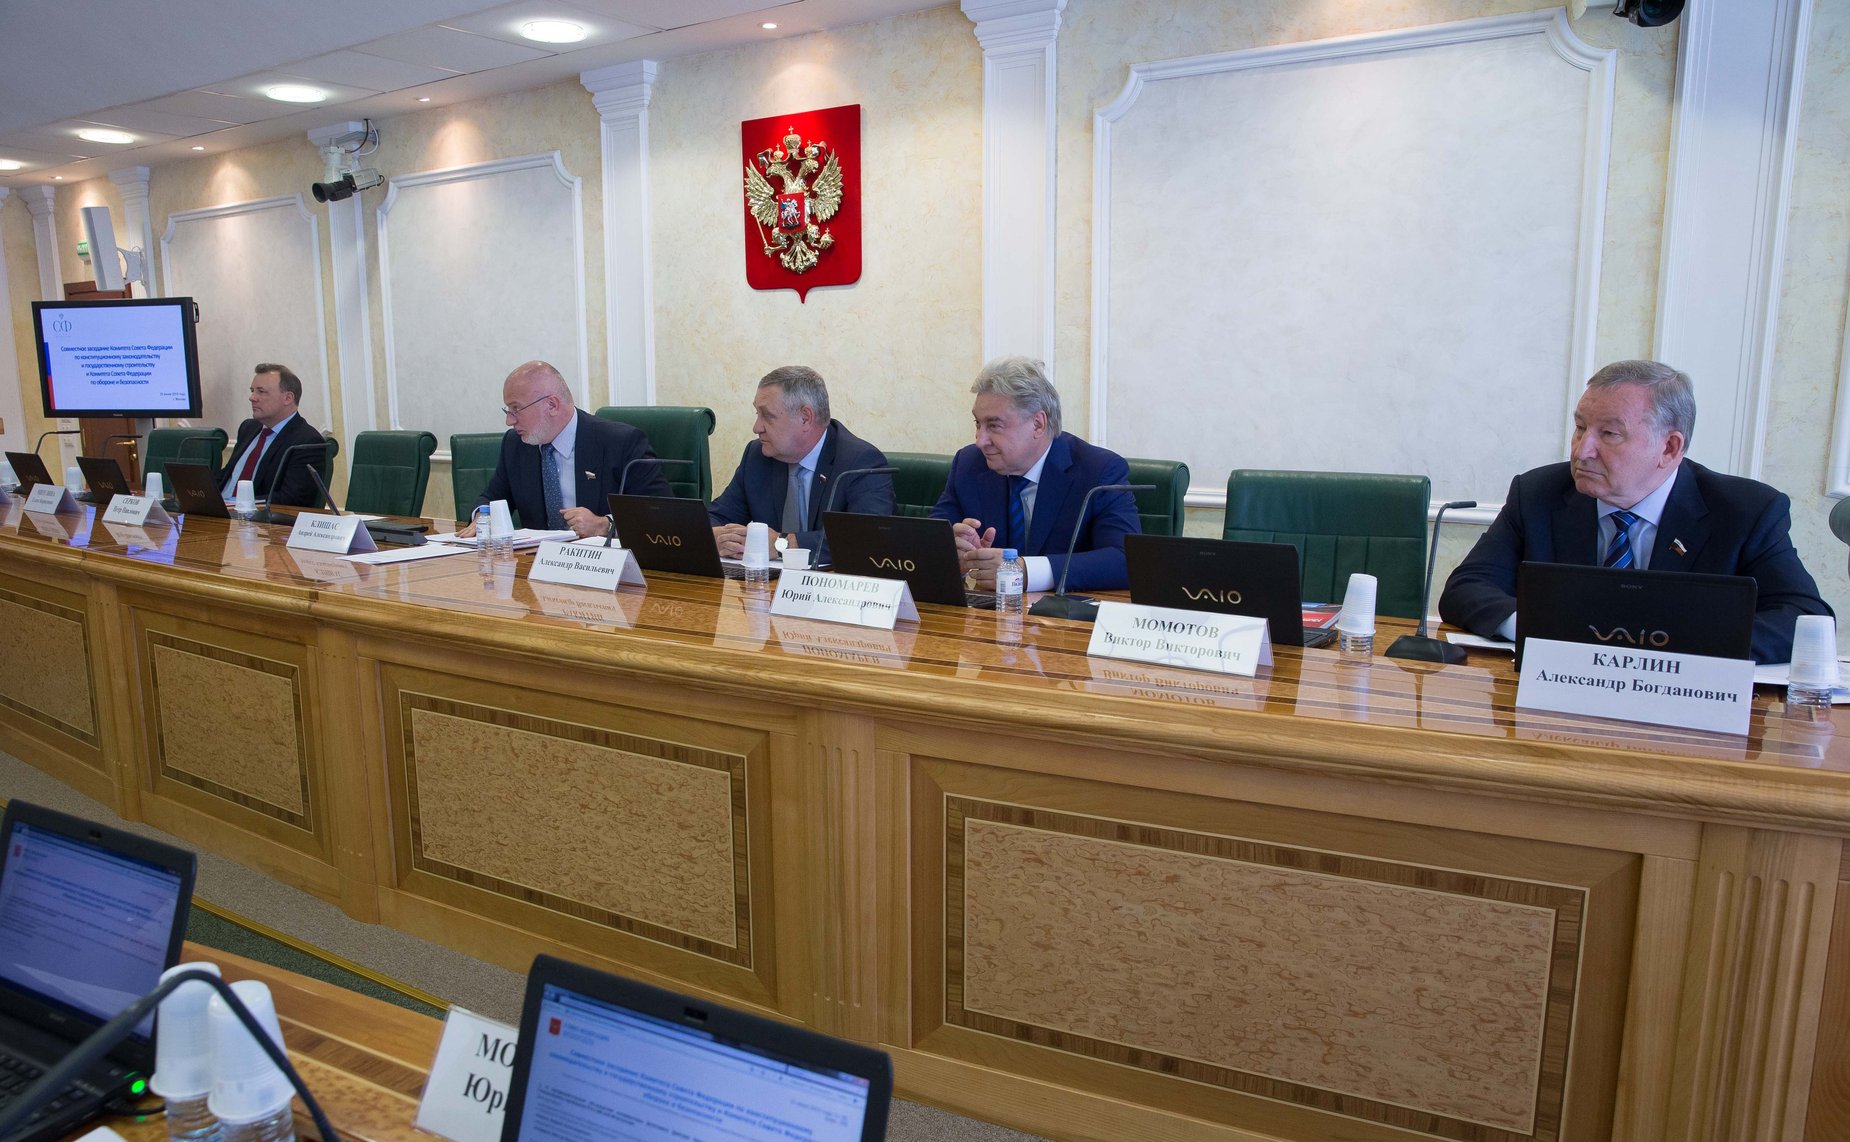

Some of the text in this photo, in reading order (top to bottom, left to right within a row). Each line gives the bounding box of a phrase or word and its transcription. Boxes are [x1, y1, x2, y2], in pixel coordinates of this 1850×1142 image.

[310, 520, 340, 530] КЛИШАС
[646, 533, 682, 546] VAIO
[560, 546, 602, 560] РАКИТИН
[540, 558, 615, 575] Александр Васильевич
[869, 556, 916, 572] VAIO
[801, 575, 880, 593] ПОНОМАРЕВ
[782, 589, 891, 610] Юрий Александрович
[1182, 586, 1242, 604] VAIO
[1132, 617, 1220, 638] МОМОТОВ
[1588, 624, 1670, 646] VAIO
[1104, 632, 1241, 661] Виктор Викторович
[1592, 652, 1682, 674] КАРЛИН
[1536, 669, 1738, 702] Александр Богданович
[476, 1032, 517, 1068] МО
[463, 1072, 507, 1114] Юр
